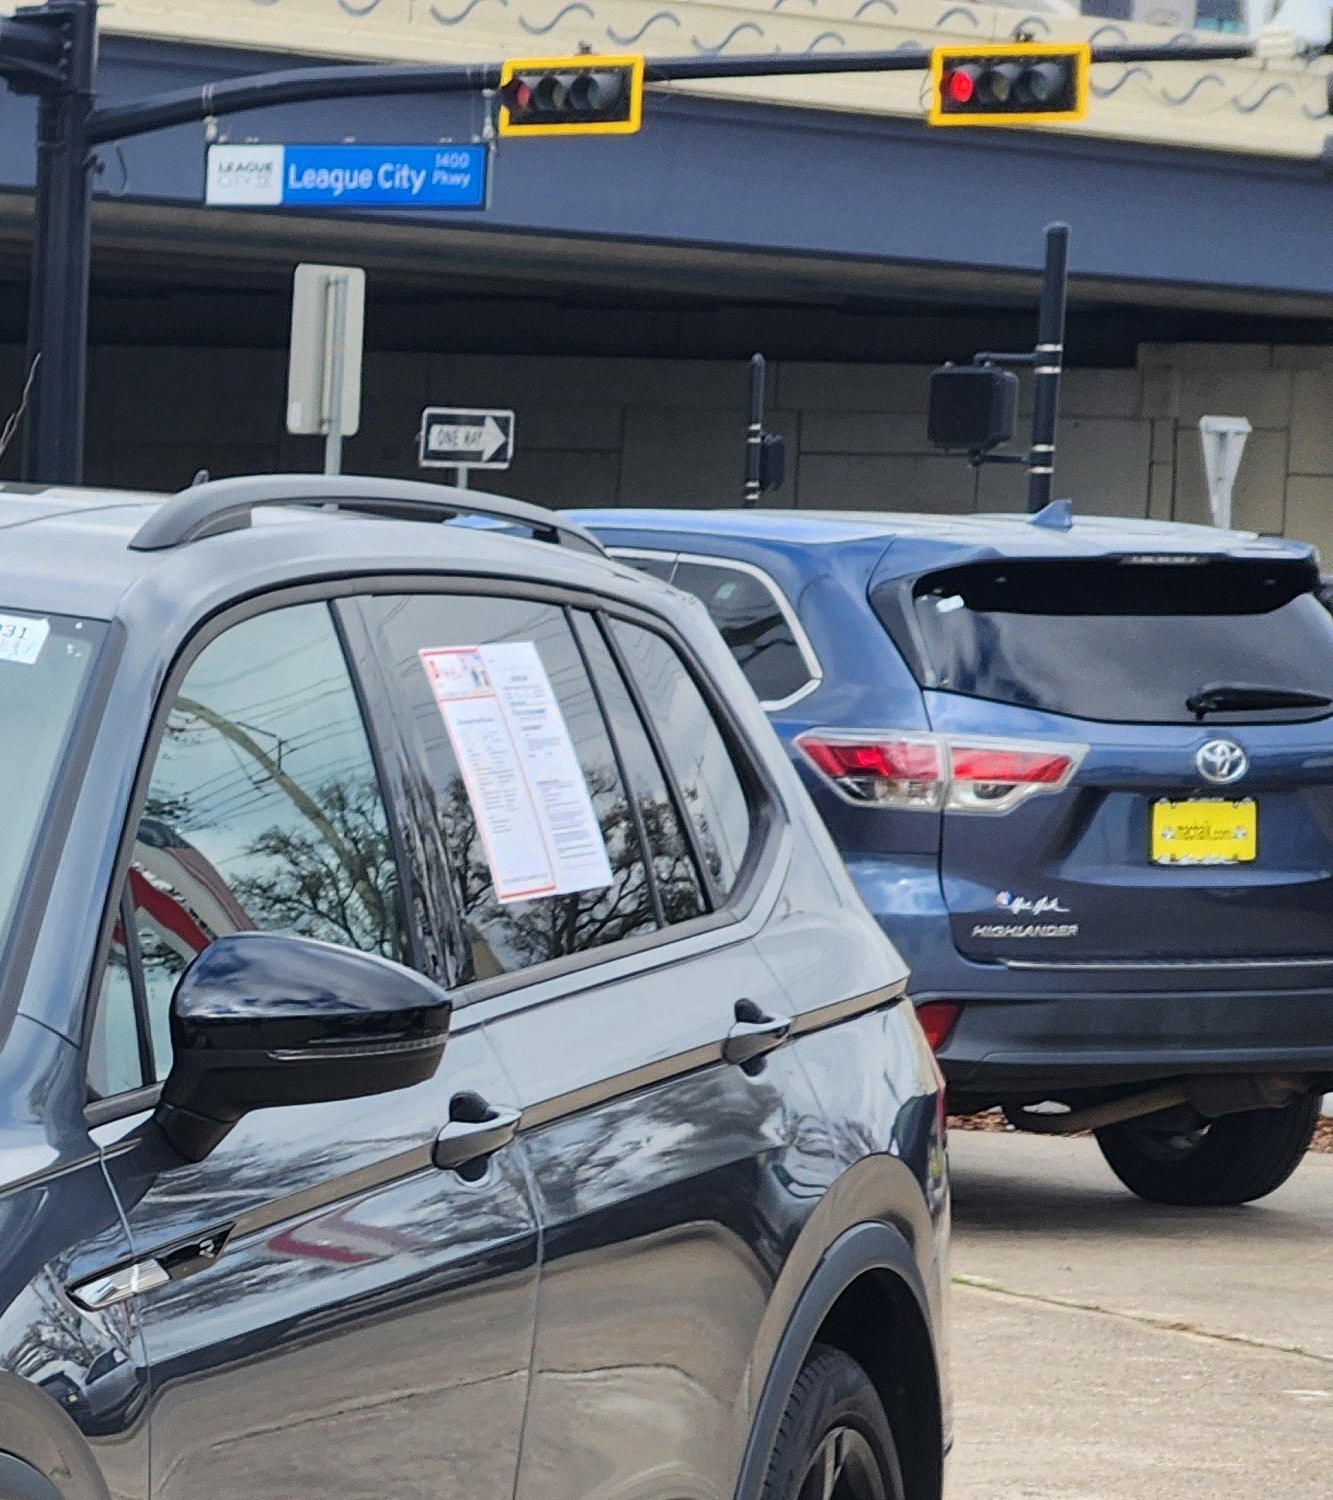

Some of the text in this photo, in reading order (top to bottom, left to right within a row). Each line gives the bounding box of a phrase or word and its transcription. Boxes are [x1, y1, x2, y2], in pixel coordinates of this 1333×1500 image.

[218, 161, 274, 173] LEAGUE
[288, 162, 426, 196] League City
[432, 170, 471, 188] Pkwy
[437, 428, 459, 447] ONE
[971, 924, 1079, 938] HIGHLANDER
